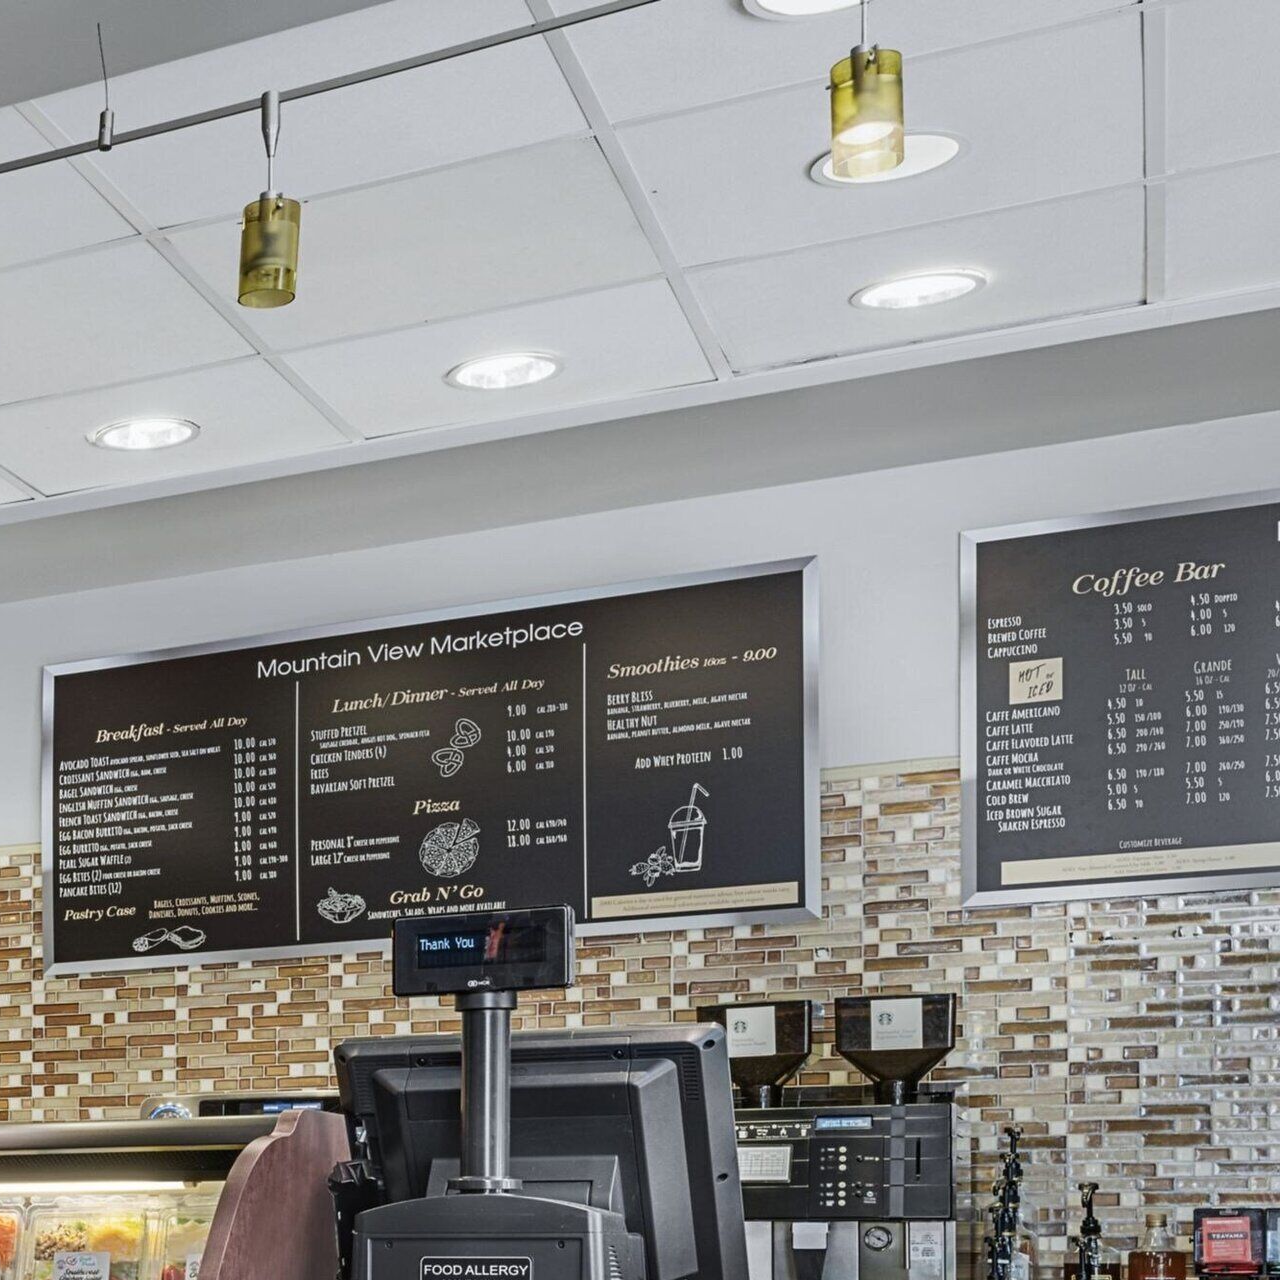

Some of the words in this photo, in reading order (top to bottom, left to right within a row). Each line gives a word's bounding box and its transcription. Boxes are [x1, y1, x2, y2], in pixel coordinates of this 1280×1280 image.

[1072, 566, 1164, 598] Coffee
[1173, 562, 1225, 582] Bar
[1114, 602, 1132, 615] 3.50
[1114, 617, 1132, 630] 3.50
[1114, 633, 1132, 645] 5.50
[257, 649, 360, 679] Mountain
[368, 644, 424, 663] View
[430, 622, 584, 655] Marketplace
[607, 655, 699, 679] Smoothies
[743, 647, 777, 662] 9.00
[1018, 663, 1046, 683] HOT
[1126, 669, 1146, 681] TALL
[332, 688, 449, 713] Lunch/Dinner
[458, 683, 497, 698] Served
[502, 680, 518, 692] All
[522, 678, 544, 690] Day
[1027, 681, 1053, 699] ICED
[96, 723, 163, 743] Breakfast
[173, 720, 206, 733] Served
[210, 717, 223, 729] All
[227, 717, 247, 727] Day
[507, 728, 530, 742] 10.00
[234, 737, 255, 750] 10.00
[234, 752, 255, 765] 10.00
[722, 747, 742, 761] 1.00
[234, 767, 255, 779] 10.00
[507, 760, 526, 773] 6.00
[234, 781, 255, 794] 10.00
[234, 796, 255, 808] 10.00
[413, 800, 460, 815] Pizza
[507, 818, 530, 831] 12.00
[508, 834, 530, 847] 18.00
[92, 870, 102, 881] (2)
[108, 882, 122, 895] (12)
[390, 889, 430, 904] Grab
[460, 885, 484, 899] Go
[64, 907, 104, 921] Pastry
[107, 906, 136, 917] Case
[420, 939, 450, 950] Thank
[455, 938, 475, 948] You
[424, 1265, 462, 1275] FOOD
[465, 1265, 528, 1276] ALLERGY
